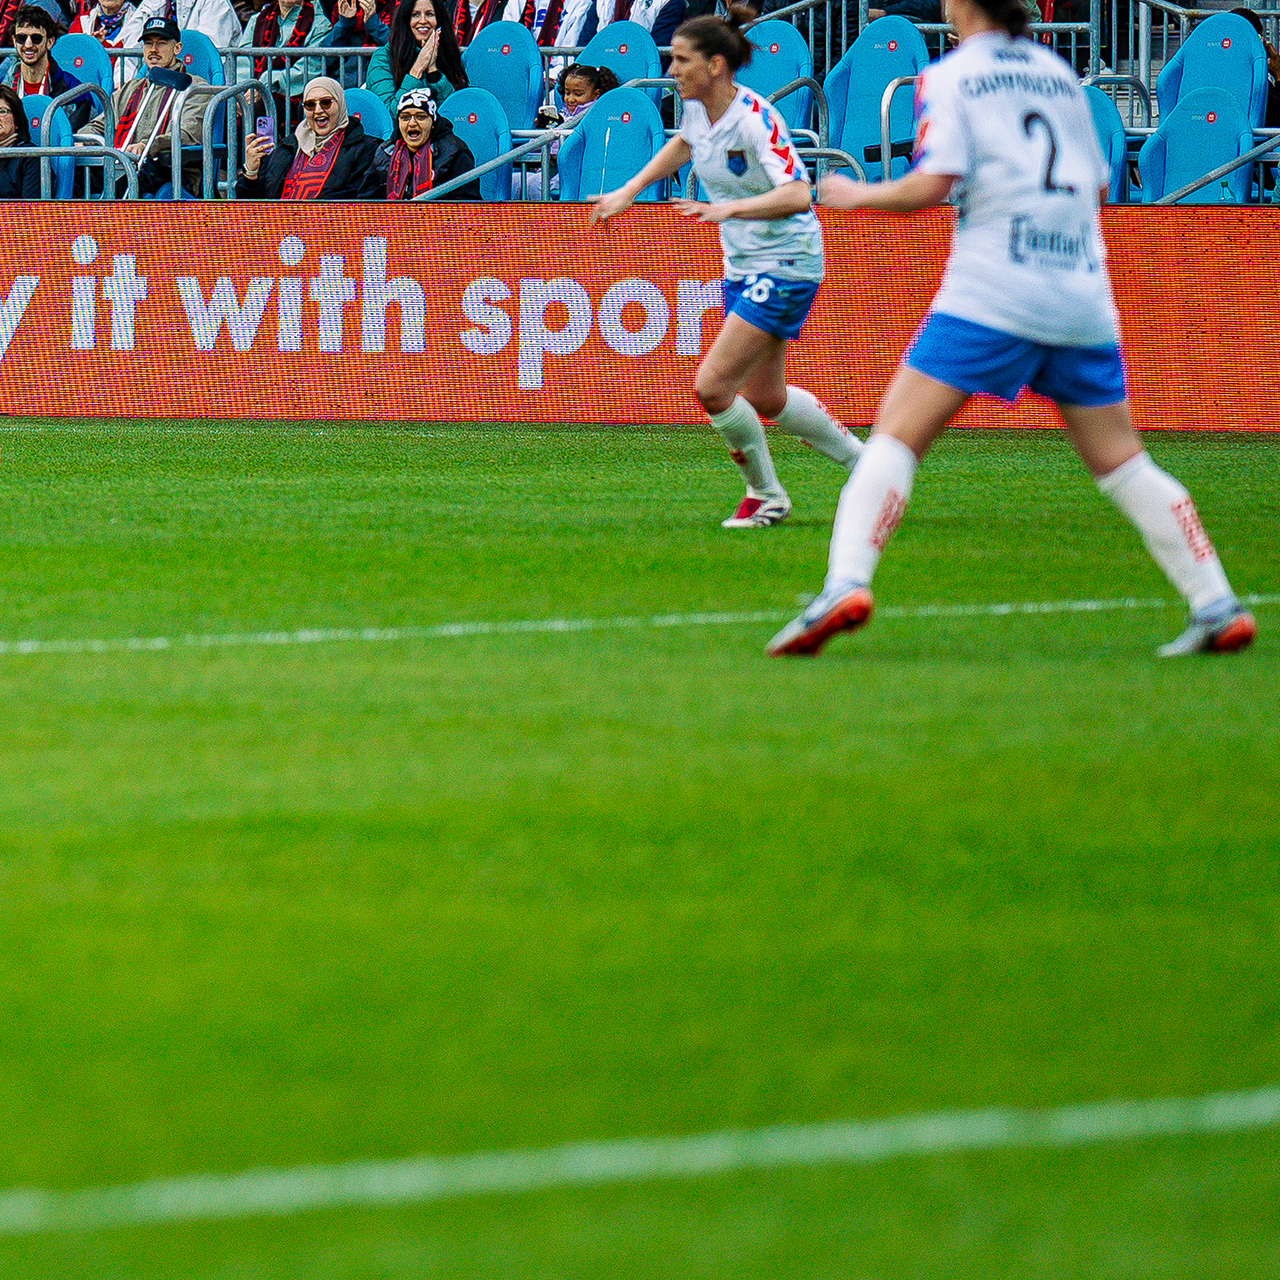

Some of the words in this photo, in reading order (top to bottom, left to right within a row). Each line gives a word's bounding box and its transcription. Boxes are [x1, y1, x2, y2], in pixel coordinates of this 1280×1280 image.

[1024, 110, 1077, 196] 2
[71, 235, 148, 351] it
[176, 235, 426, 353] with
[460, 276, 724, 389] spor
